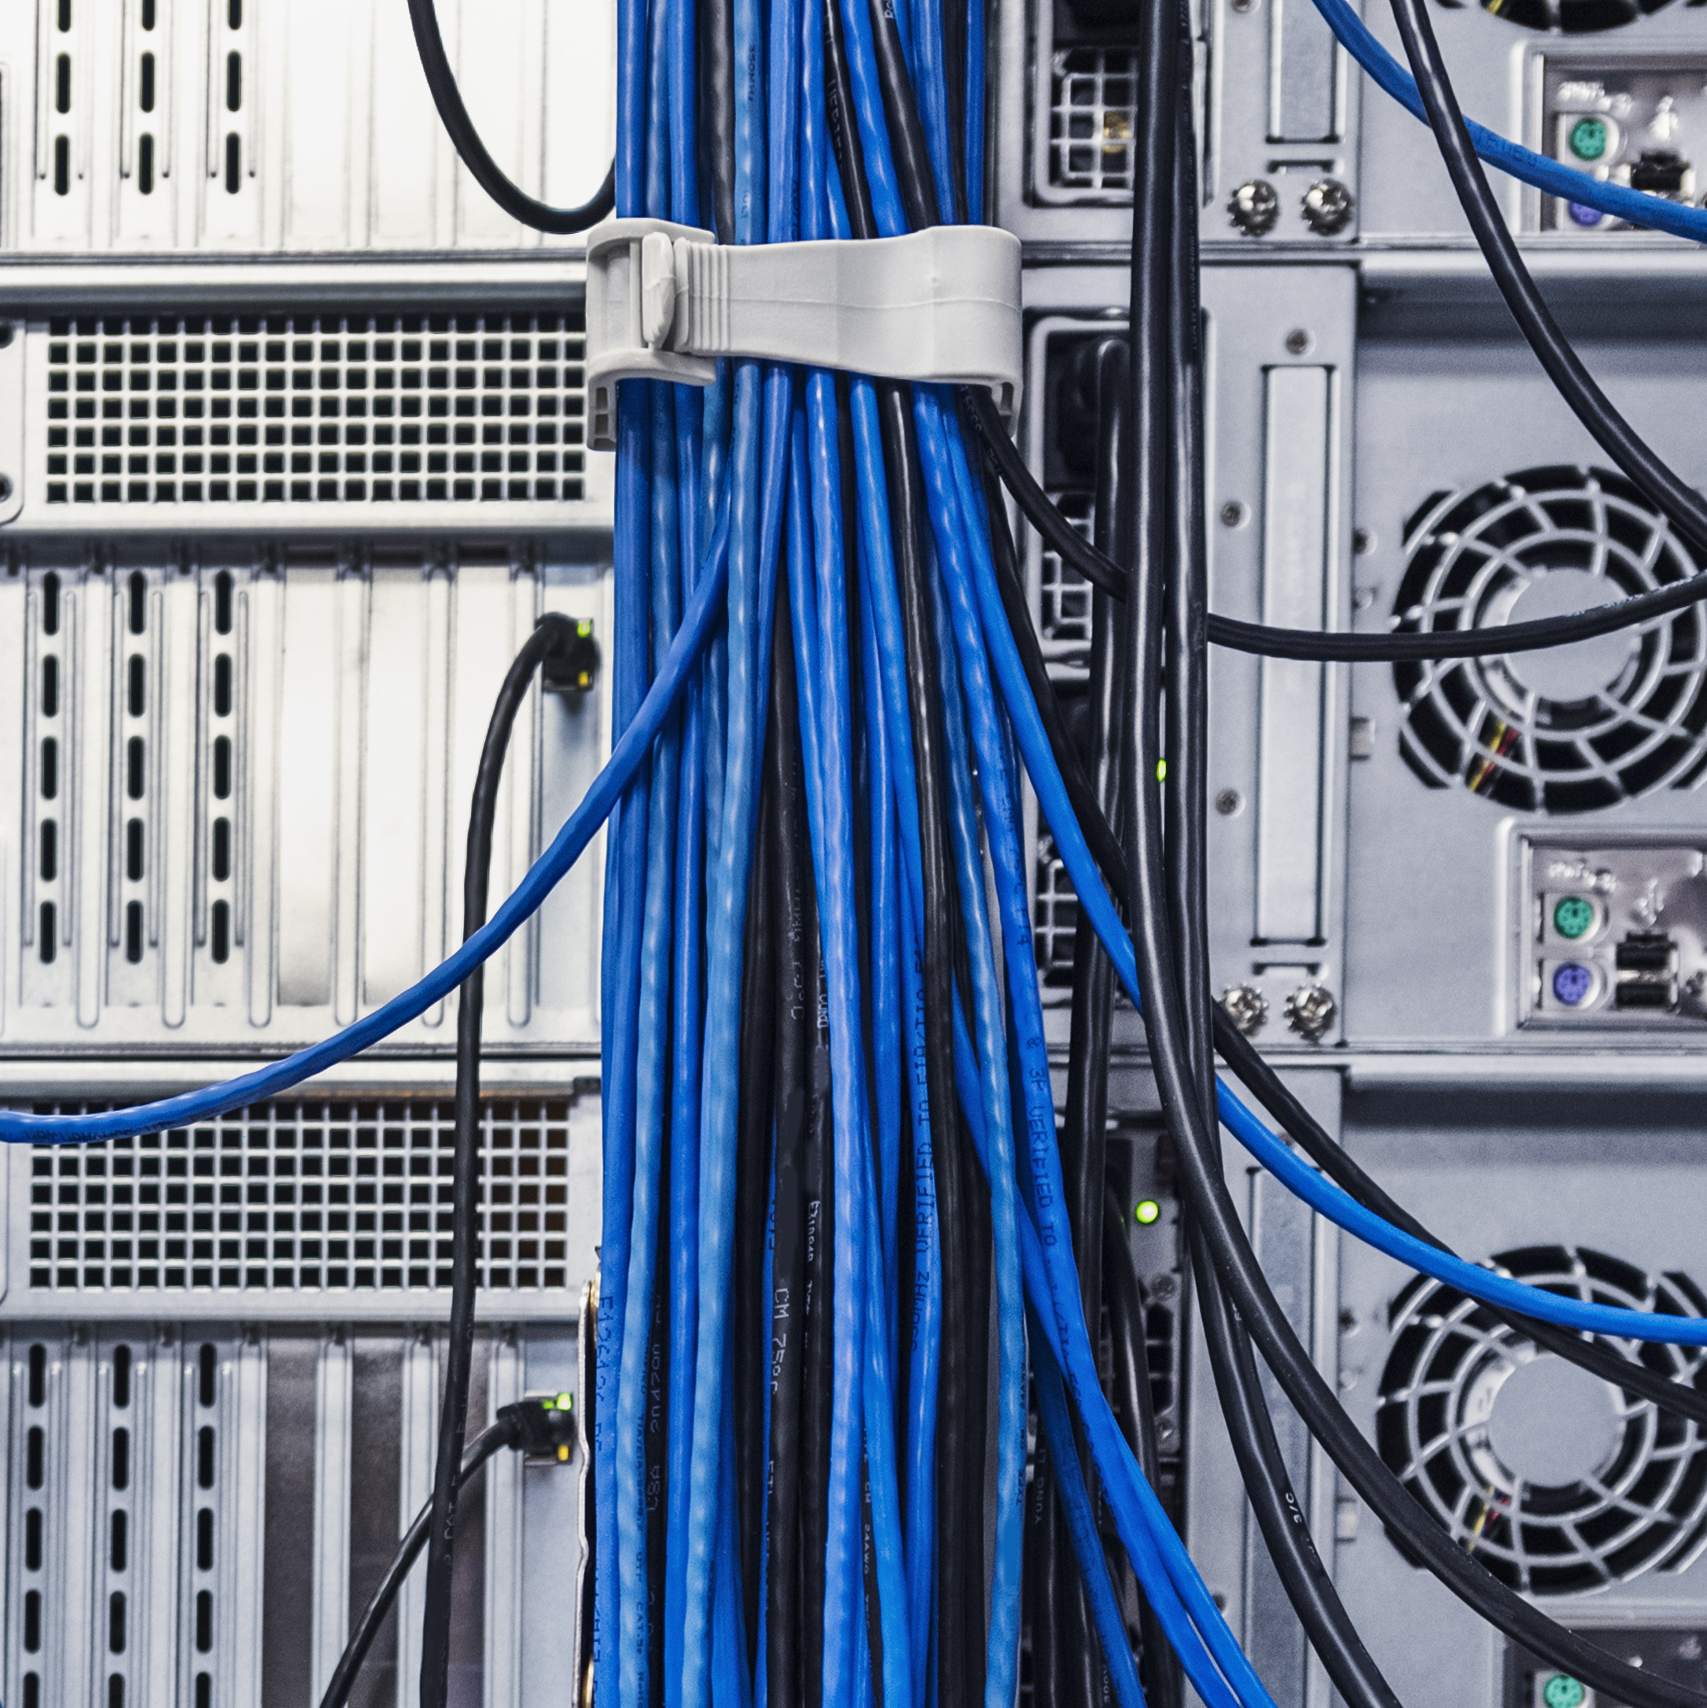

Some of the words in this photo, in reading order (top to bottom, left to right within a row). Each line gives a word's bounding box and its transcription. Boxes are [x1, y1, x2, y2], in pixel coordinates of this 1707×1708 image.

[1028, 1105, 1054, 1209] VERIFIED
[1041, 1221, 1058, 1247] TO
[772, 1287, 790, 1321] CM
[1033, 1475, 1046, 1525] YUNG
[1284, 1489, 1303, 1525] 3/C
